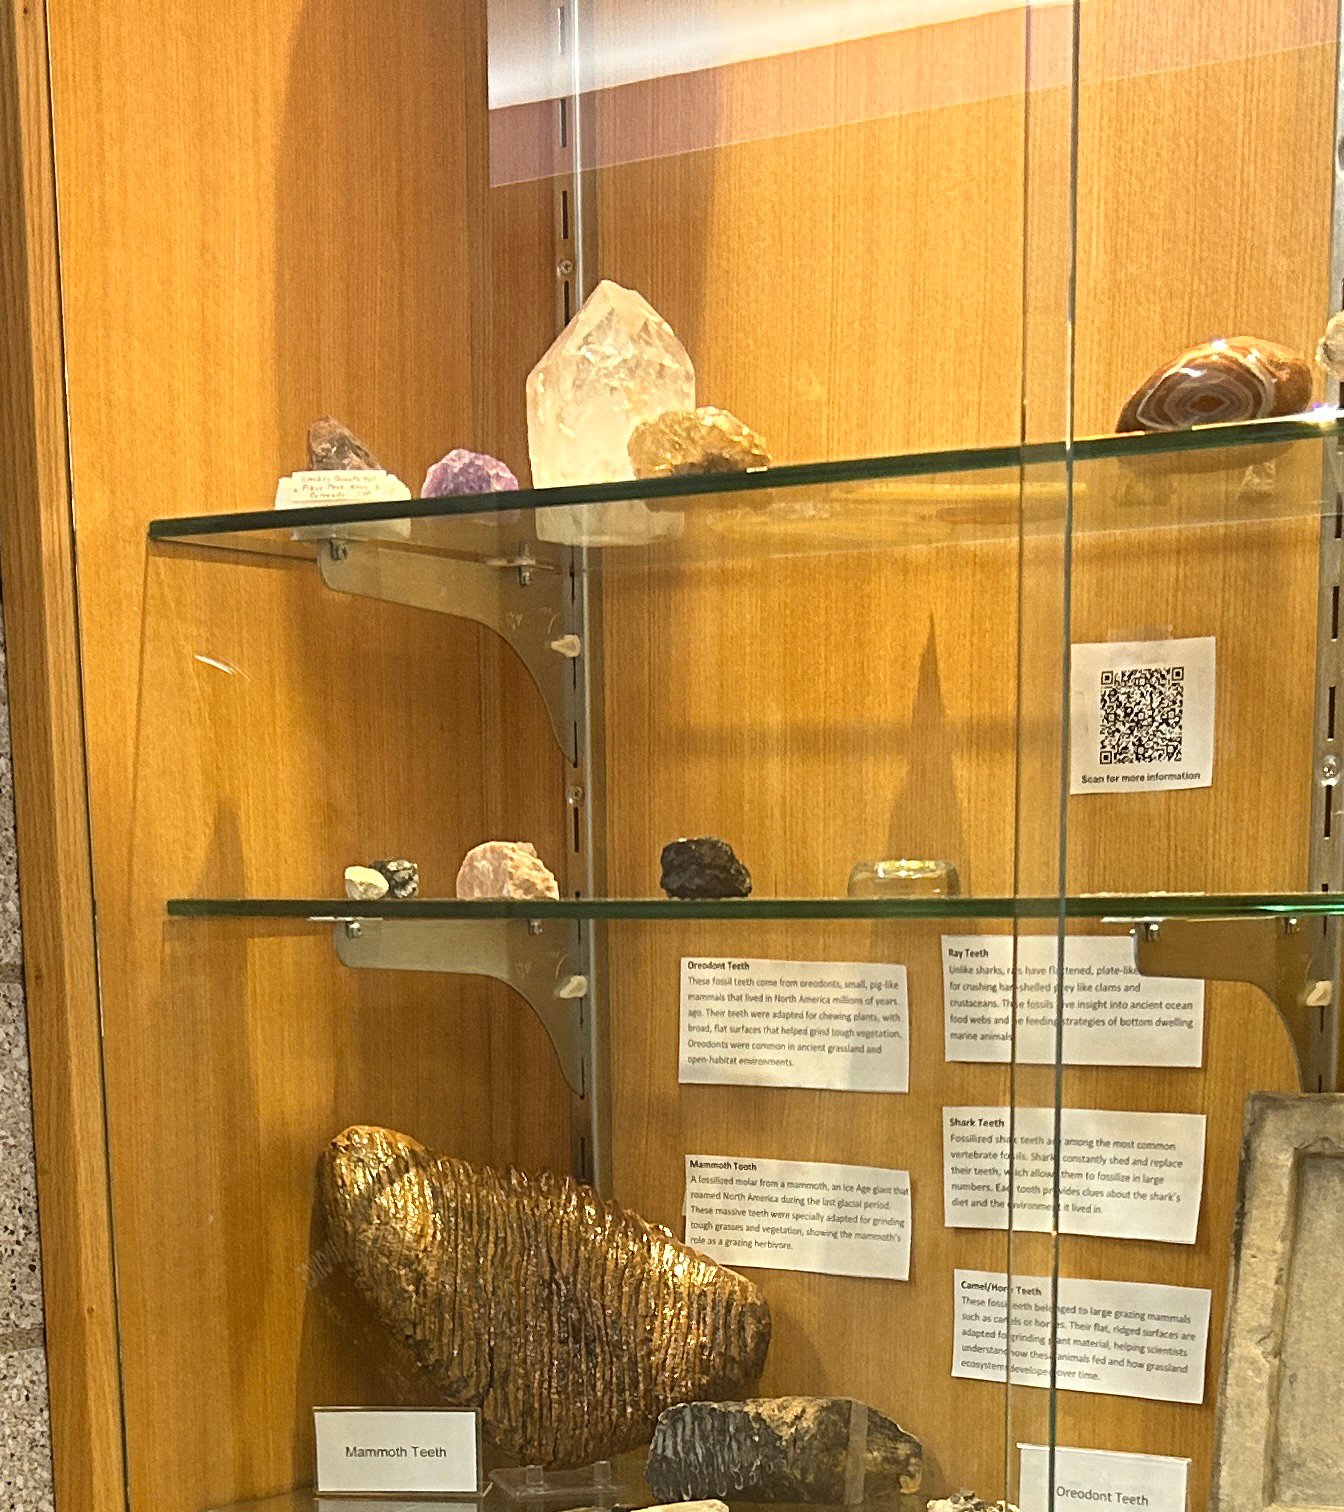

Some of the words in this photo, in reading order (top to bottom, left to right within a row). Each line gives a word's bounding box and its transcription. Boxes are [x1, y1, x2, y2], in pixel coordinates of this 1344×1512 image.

[1082, 774, 1104, 784] Scan
[1106, 774, 1118, 782] for
[1122, 774, 1145, 782] more
[1147, 772, 1200, 782] information
[964, 949, 988, 958] Teeth
[688, 961, 725, 970] Oreodont
[728, 962, 750, 970] Teeth
[950, 1118, 976, 1128] Shark
[978, 1118, 1004, 1128] Teeth
[690, 1160, 731, 1170] Mammoth
[345, 1446, 407, 1458] Mammoth
[412, 1446, 446, 1458] Teeth
[1056, 1486, 1112, 1502] Oreodont
[1116, 1492, 1148, 1506] Teeth
